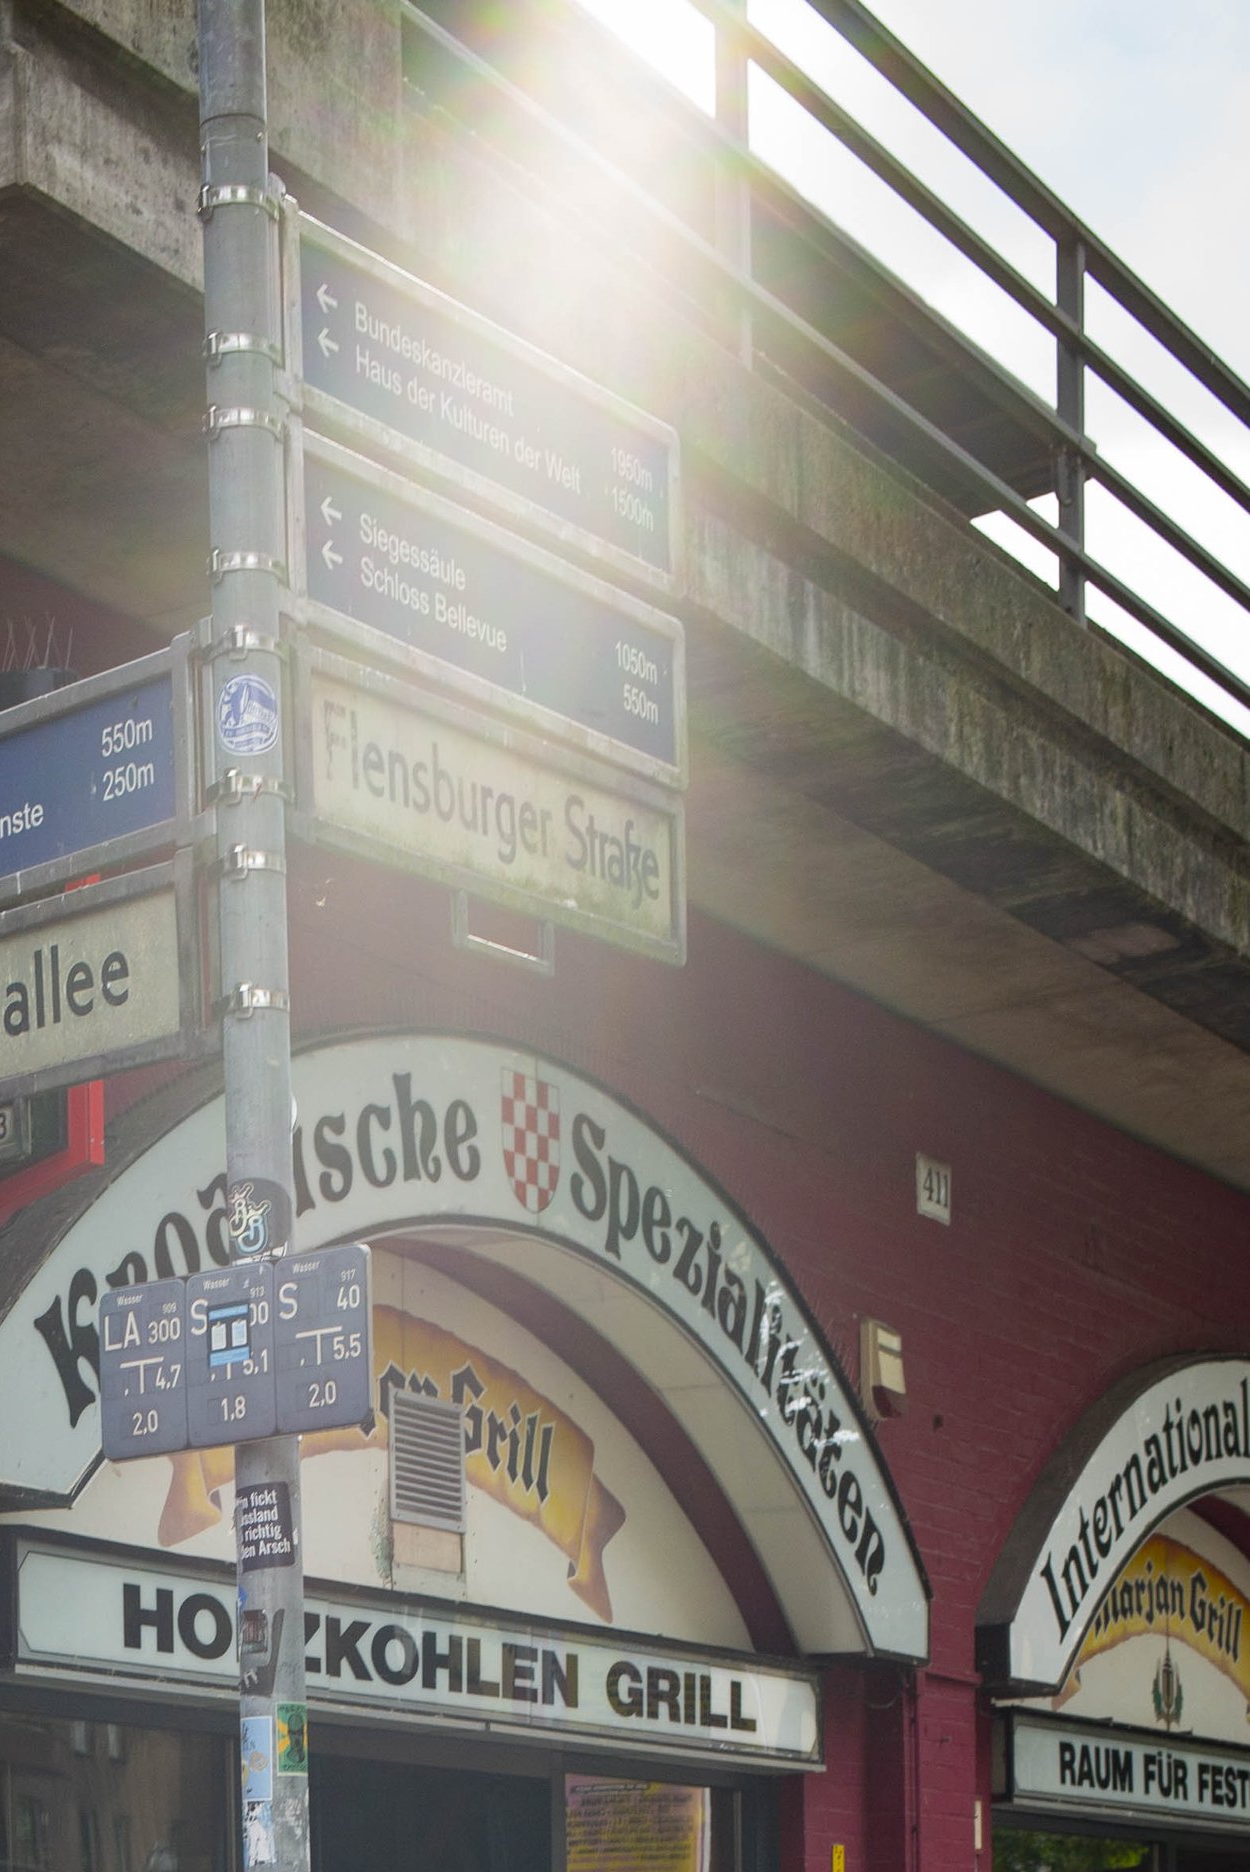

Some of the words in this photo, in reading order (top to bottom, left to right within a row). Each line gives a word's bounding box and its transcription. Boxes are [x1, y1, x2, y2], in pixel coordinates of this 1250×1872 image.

[354, 302, 514, 417] Bundeskanzleramt
[355, 344, 403, 396] Haus
[406, 381, 435, 411] der
[440, 394, 511, 454] Kulturen
[513, 437, 541, 473] der
[545, 451, 582, 496] Welt
[610, 446, 653, 490] 1950m
[611, 487, 654, 533] 1500m
[360, 513, 466, 591] Siegessäule
[360, 558, 430, 614] Schloss
[435, 597, 508, 653] Bellevue
[615, 640, 658, 683] 1050m
[623, 683, 659, 725] 550m
[101, 718, 153, 758] 550m
[103, 762, 155, 802] 250m
[323, 697, 552, 865] Flensburger
[563, 795, 660, 908] Straße
[203, 1279, 230, 1291] Wasser
[292, 1261, 321, 1274] Wasser
[191, 1299, 209, 1336] S
[279, 1282, 298, 1320] S
[336, 1284, 360, 1310] 40
[104, 1310, 141, 1352] LA
[147, 1317, 181, 1345] 300
[333, 1332, 361, 1360] 5,5
[243, 1349, 269, 1376] 5,1
[568, 1109, 885, 1598] Spezialitäten
[155, 1364, 181, 1390] 4,7
[309, 1381, 337, 1408] 2,0
[133, 1410, 159, 1436] 2,0
[221, 1396, 246, 1422] 1,8
[250, 1490, 277, 1509] fickt
[245, 1524, 282, 1542] richtig
[258, 1539, 291, 1557] Arsch
[1189, 1568, 1243, 1664] Grill
[122, 1582, 579, 1710] HOZKOHLEN
[605, 1659, 758, 1734] GRILL
[1058, 1740, 1134, 1793] RAUM
[1143, 1749, 1189, 1802] FÜR
